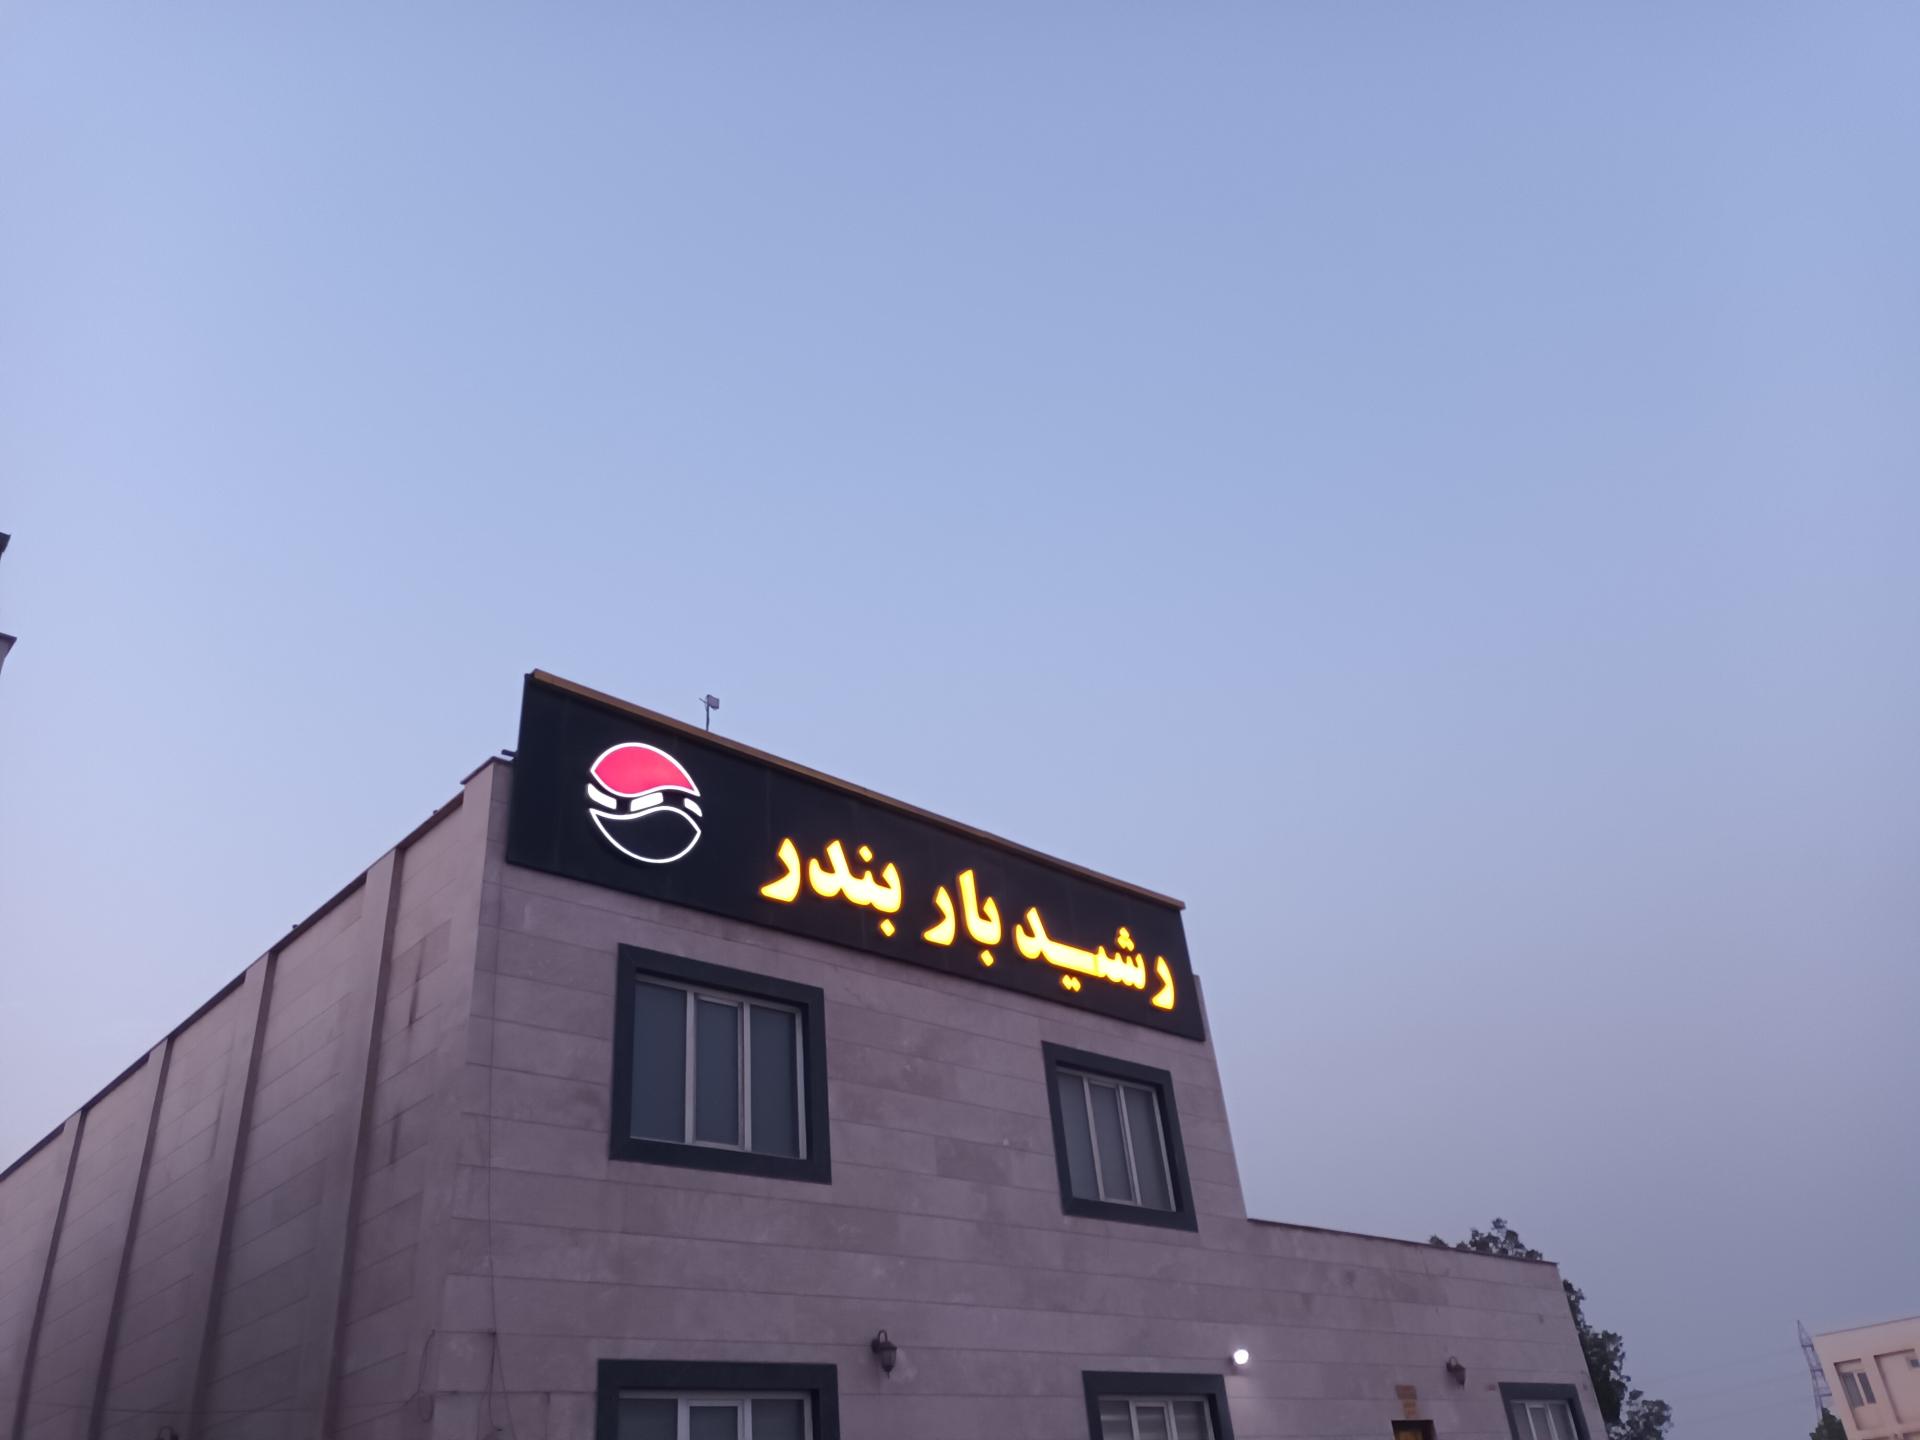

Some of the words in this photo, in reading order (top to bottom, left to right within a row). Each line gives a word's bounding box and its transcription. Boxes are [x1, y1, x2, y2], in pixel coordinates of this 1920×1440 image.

[760, 838, 902, 937] بندر
[923, 869, 1001, 967] بار
[1014, 906, 1175, 1010] رشید
